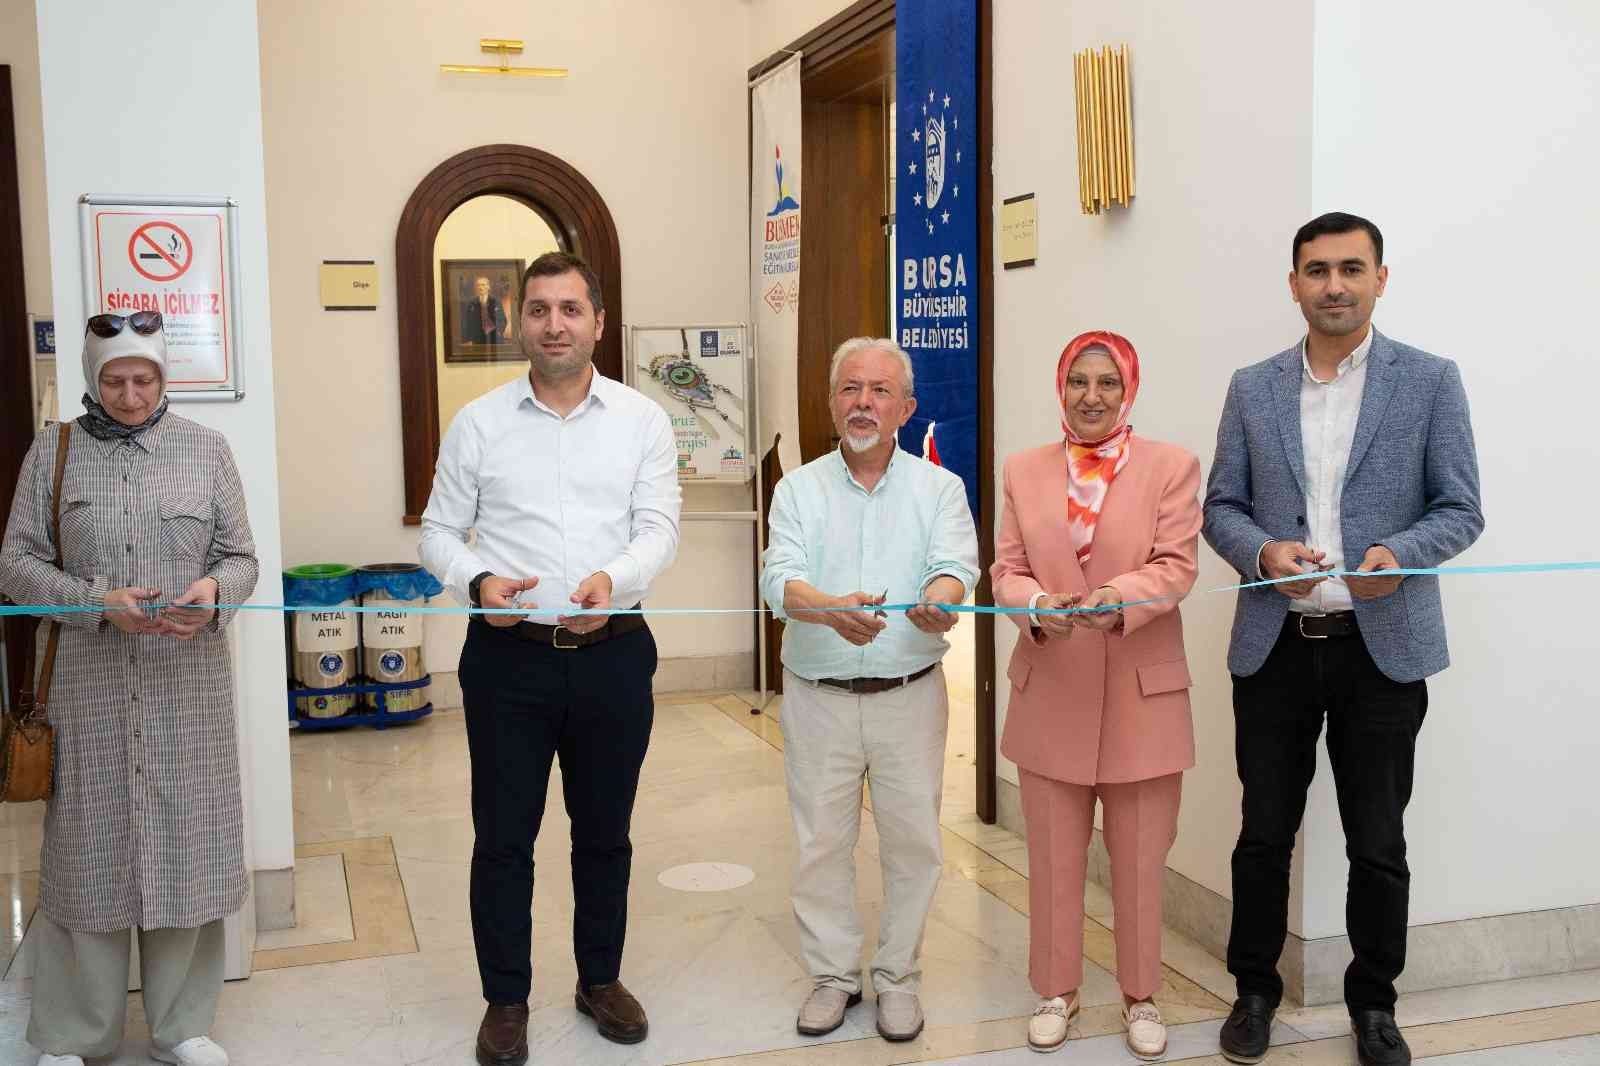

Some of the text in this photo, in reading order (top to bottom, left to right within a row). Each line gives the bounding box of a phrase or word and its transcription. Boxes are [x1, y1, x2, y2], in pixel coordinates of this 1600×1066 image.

[904, 253, 967, 290] BURSA
[311, 610, 346, 622] METAL
[318, 627, 342, 638] ATIK
[380, 625, 405, 635] ATIK
